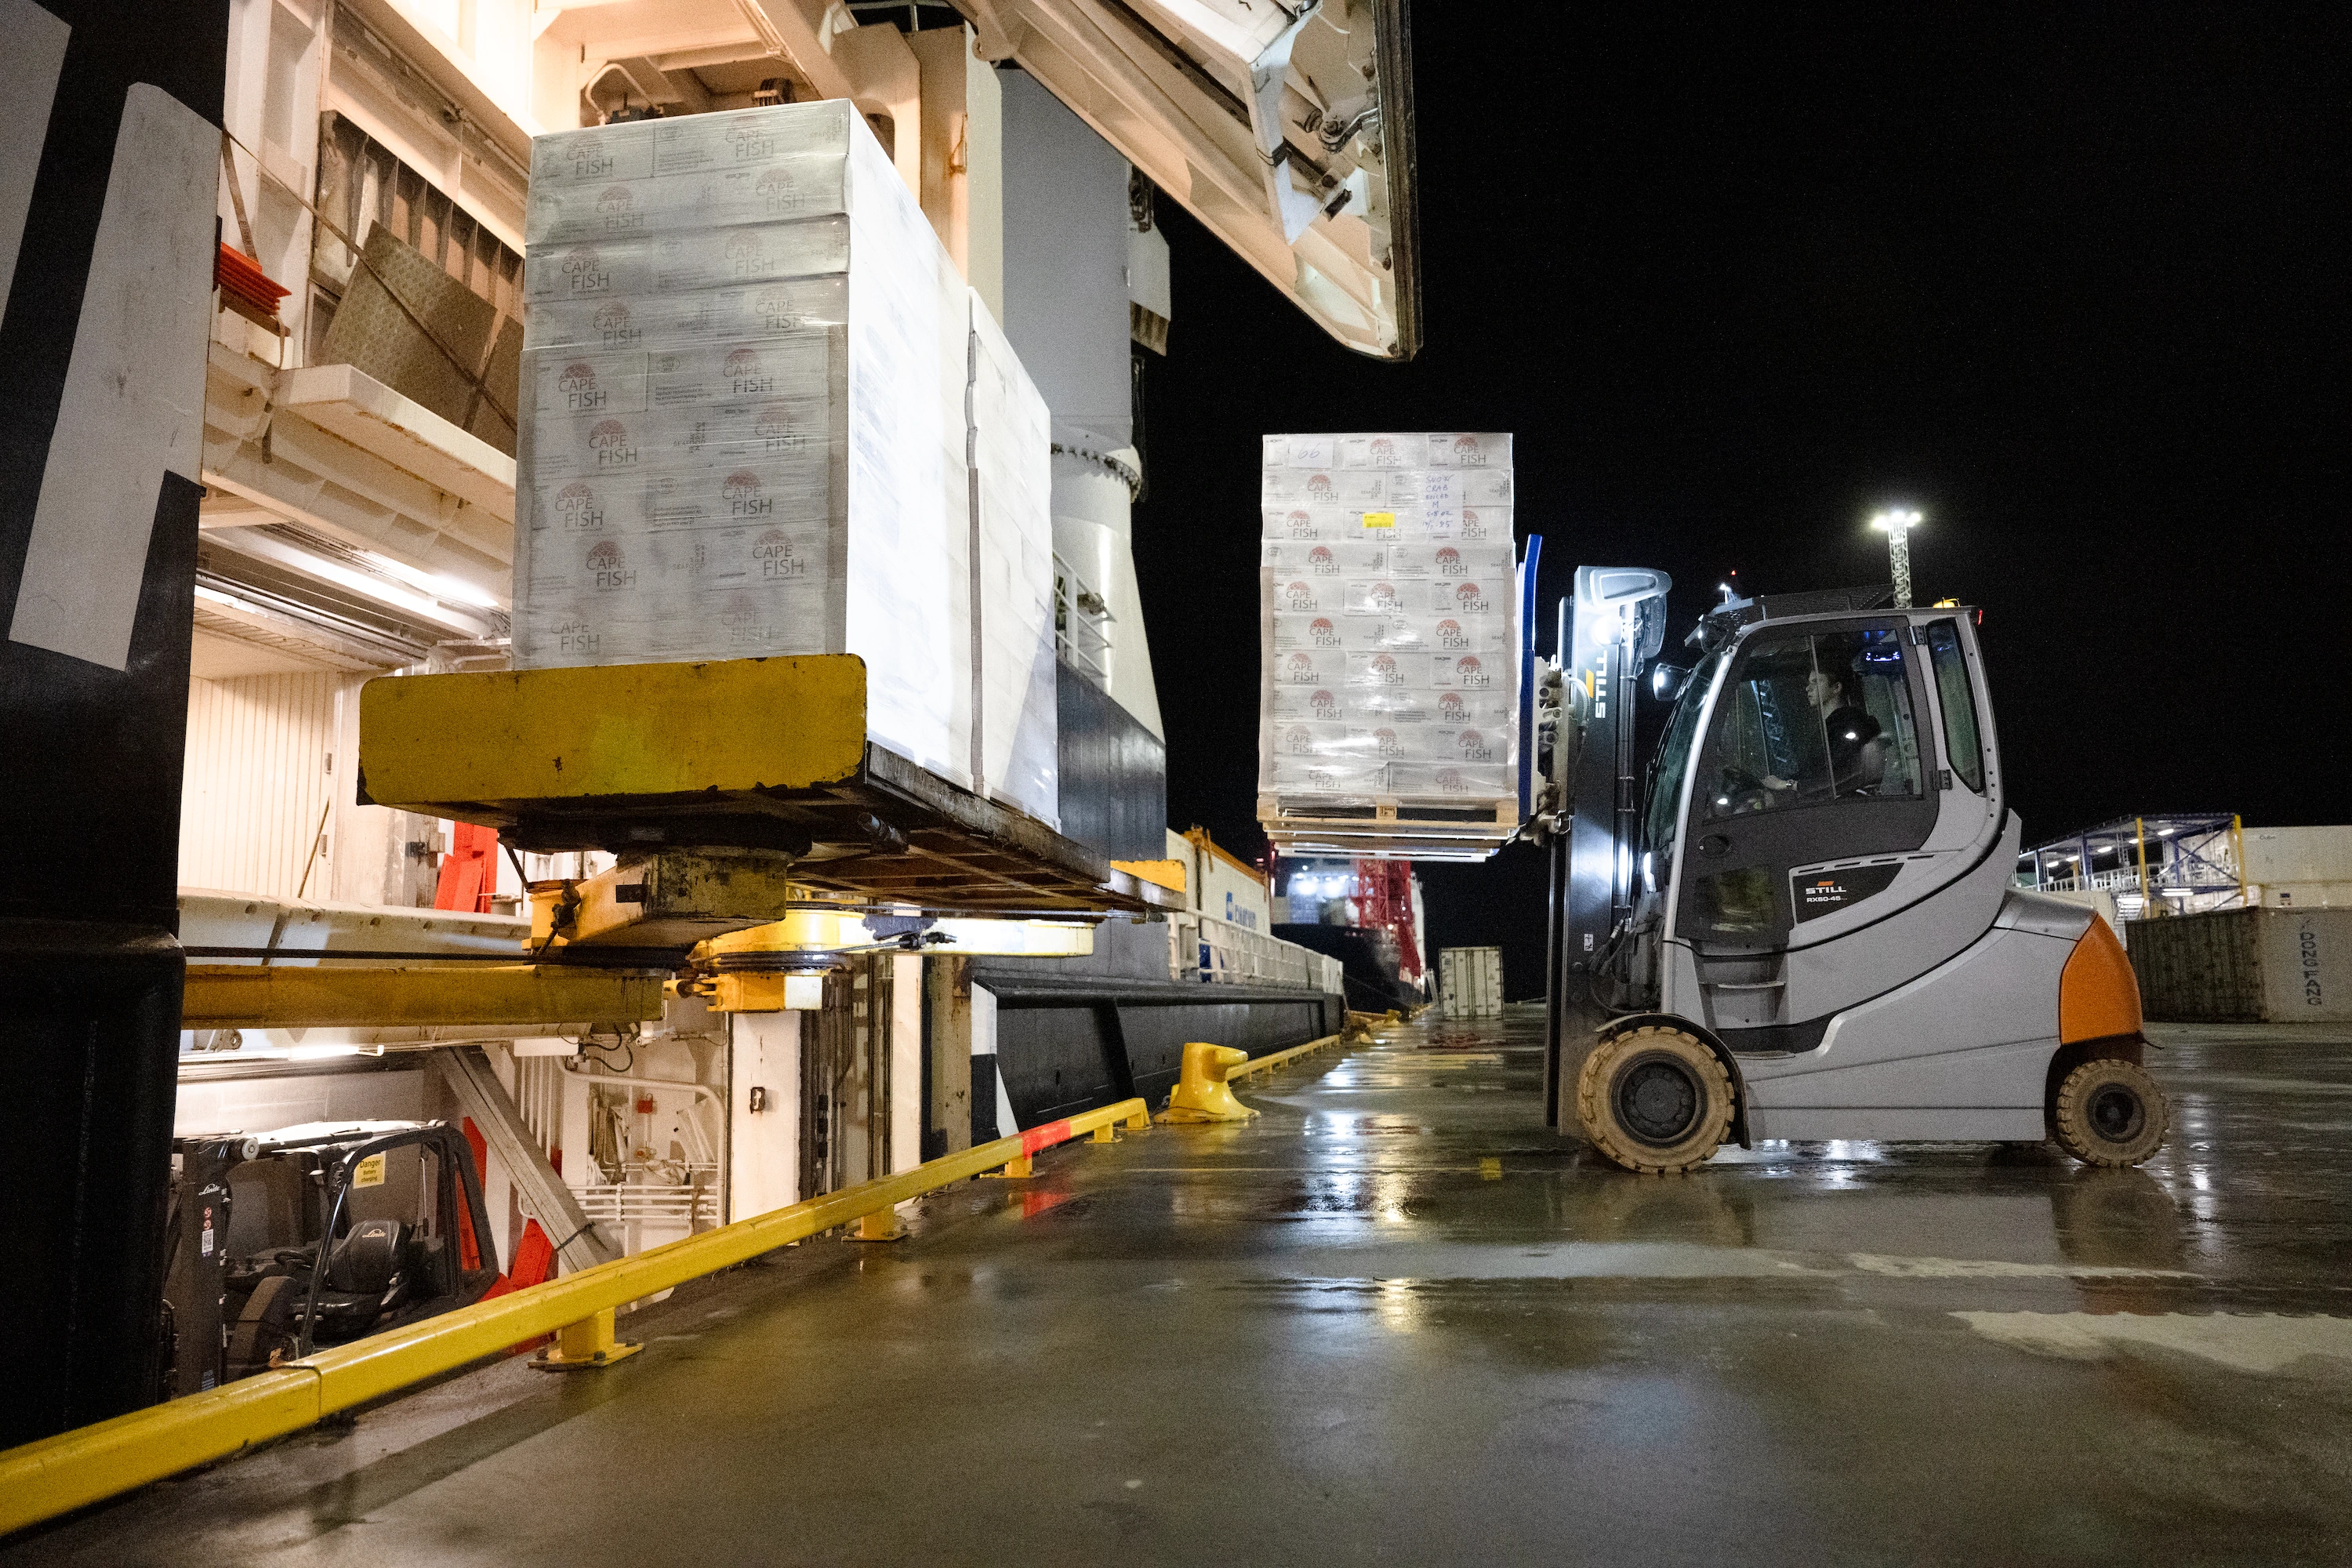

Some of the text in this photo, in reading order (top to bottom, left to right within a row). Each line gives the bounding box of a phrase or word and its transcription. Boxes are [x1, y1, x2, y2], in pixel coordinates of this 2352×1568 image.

[566, 147, 604, 161] CAPE
[735, 140, 775, 158] FISH
[575, 158, 613, 176] FISH
[756, 180, 794, 196] CAPE
[596, 199, 633, 213] CAPE
[766, 193, 805, 211] FISH
[605, 212, 644, 229] FISH
[724, 245, 764, 260] CAPE
[561, 260, 600, 274] CAPE
[735, 258, 775, 274] FISH
[571, 272, 610, 289] FISH
[755, 299, 794, 314] CAPE
[593, 315, 632, 331] CAPE
[602, 328, 641, 347] FISH
[722, 364, 761, 378] CAPE
[557, 378, 597, 392] CAPE
[732, 376, 773, 394] FISH
[568, 390, 607, 408] FISH
[754, 421, 794, 436] CAPE
[588, 434, 627, 449] CAPE
[765, 434, 805, 452] FISH
[1298, 442, 1321, 459] 66
[1370, 447, 1396, 456] CAPE
[598, 448, 637, 466] FISH
[1376, 456, 1402, 466] FISH
[1461, 454, 1486, 464] FISH
[722, 486, 761, 500] CAPE
[1425, 484, 1448, 492] CRAB
[1313, 492, 1339, 502] FISH
[554, 497, 593, 511] CAPE
[732, 498, 772, 516] FISH
[564, 510, 603, 528] FISH
[1287, 519, 1311, 528] CAPE
[1293, 528, 1318, 538] FISH
[1376, 528, 1402, 538] FISH
[1461, 528, 1486, 538] FISH
[752, 544, 793, 559] CAPE
[586, 556, 626, 571] CAPE
[764, 558, 804, 575] FISH
[1315, 564, 1340, 574] FISH
[1442, 565, 1468, 575] FISH
[596, 570, 637, 587] FISH
[1286, 590, 1311, 599] CAPE
[1456, 592, 1482, 601] CAPE
[1292, 599, 1318, 609] FISH
[1463, 601, 1489, 611] FISH
[550, 620, 590, 634] CAPE
[1436, 628, 1462, 637] CAPE
[560, 633, 600, 652] FISH
[1316, 637, 1341, 646] FISH
[1443, 637, 1468, 648] FISH
[1294, 671, 1319, 681] FISH
[1379, 673, 1404, 683] ISH
[1464, 675, 1490, 684] FISH
[1595, 650, 1607, 718] STILL
[1310, 699, 1335, 708] CAPE
[1438, 702, 1464, 710] CAPE
[1316, 709, 1342, 718] FISH
[1445, 711, 1471, 721] FISH
[1286, 734, 1312, 742] CAPE
[1378, 737, 1397, 746] APE
[1458, 739, 1484, 749] CAPE
[1378, 746, 1404, 757] FISH
[1465, 749, 1491, 759] FISH
[1308, 771, 1333, 780] CAPE
[1436, 775, 1461, 784] CAPE
[1443, 784, 1468, 793] FISH
[1806, 886, 1847, 895] STILL
[360, 1160, 381, 1169] Danger
[198, 1183, 220, 1196] Linde
[361, 1229, 387, 1238] Linde
